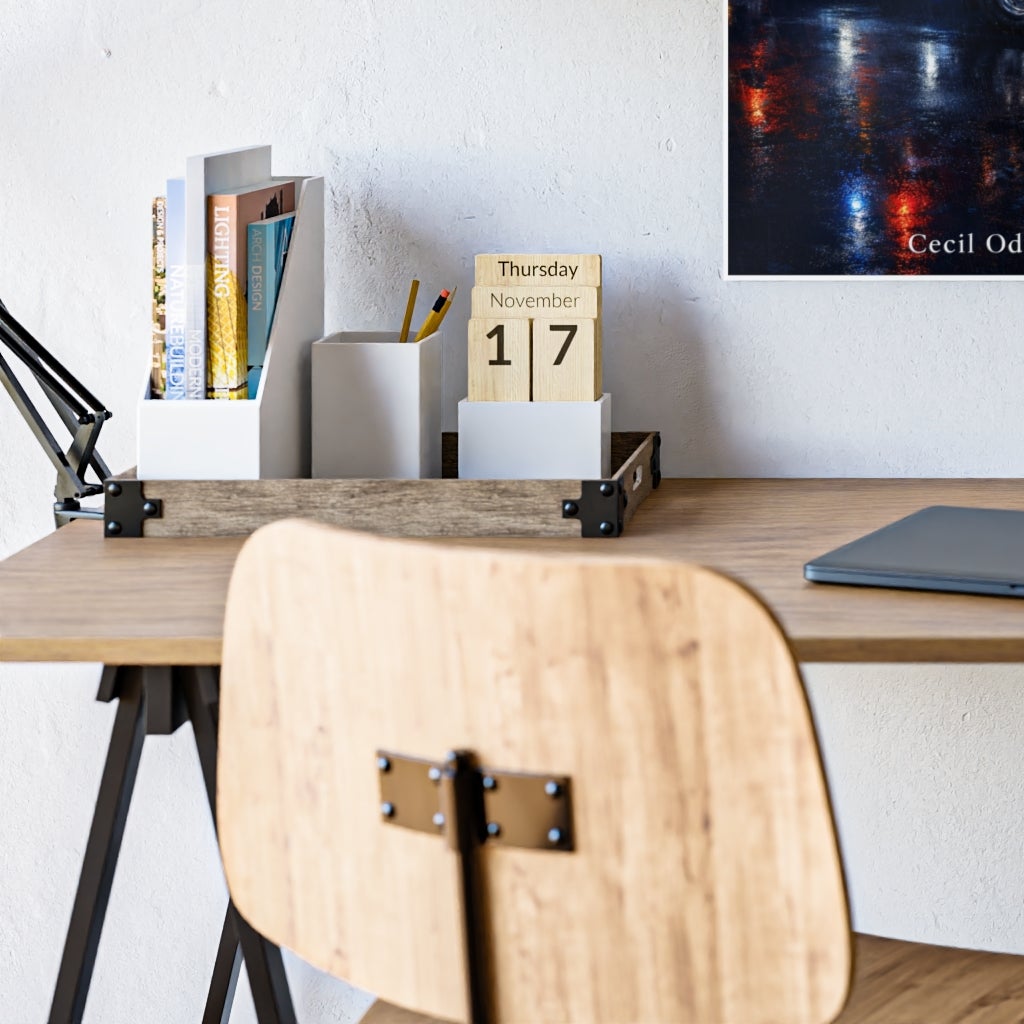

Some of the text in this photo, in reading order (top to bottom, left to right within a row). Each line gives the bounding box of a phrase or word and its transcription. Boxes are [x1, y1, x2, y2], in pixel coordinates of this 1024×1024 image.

[213, 205, 230, 299] LIGHTING
[908, 233, 975, 255] Cecil
[251, 228, 263, 312] ARCH DESIGN
[497, 260, 579, 280] Thursday
[490, 292, 580, 309] November
[188, 329, 203, 400] MODERN
[485, 324, 578, 366] 1 7
